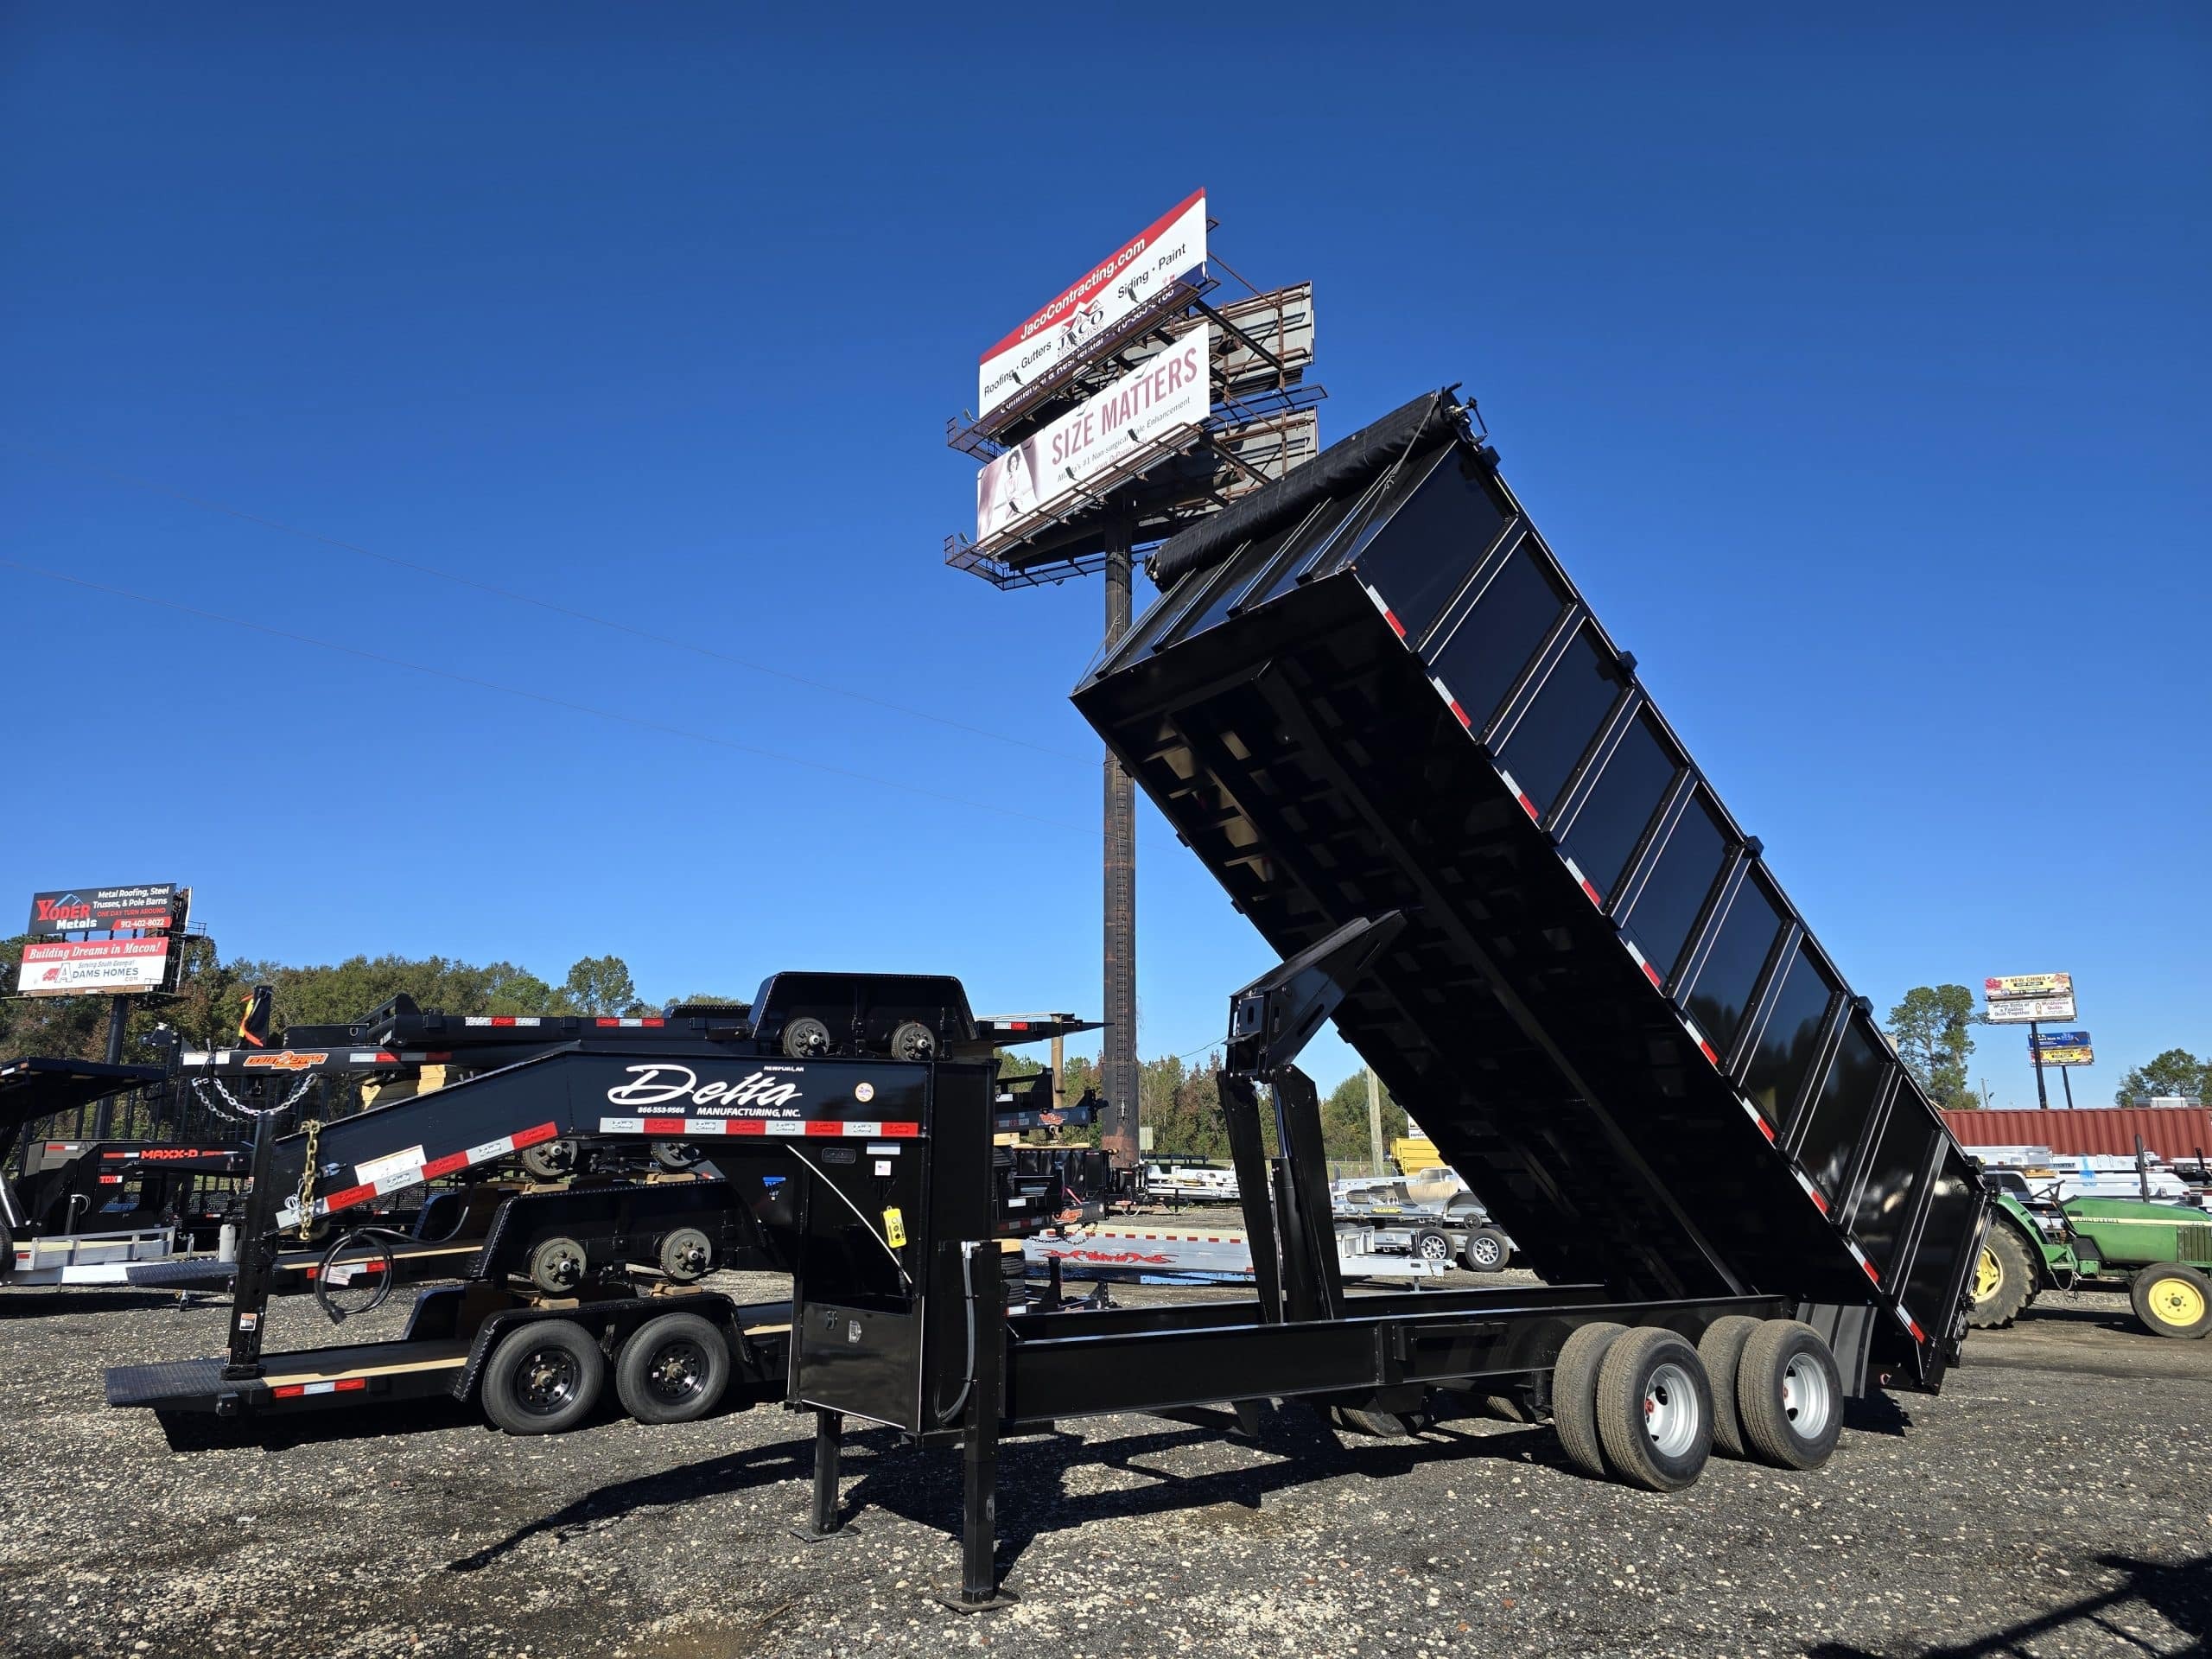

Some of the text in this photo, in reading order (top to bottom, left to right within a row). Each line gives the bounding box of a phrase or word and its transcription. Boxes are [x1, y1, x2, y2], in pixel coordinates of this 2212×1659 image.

[1117, 242, 1186, 300] Siding Paint
[1020, 238, 1146, 340] JacoContracting.com
[983, 340, 1052, 398] Roofing Gutters
[1051, 346, 1198, 466] SIZE MATTERS
[1147, 397, 1191, 428] Enhancement
[99, 886, 169, 899] Metal Roofing, Steel
[122, 899, 127, 907] &
[129, 898, 144, 906] Pole
[146, 896, 167, 906] Barns
[37, 899, 91, 920] YODER
[56, 918, 97, 931] Metals
[29, 941, 161, 960] Building Dreams in Macon!
[103, 968, 139, 976] HOMES
[607, 1064, 804, 1107] Delta
[696, 1107, 781, 1118] MANUFACTURING,
[781, 1108, 802, 1118] INC.
